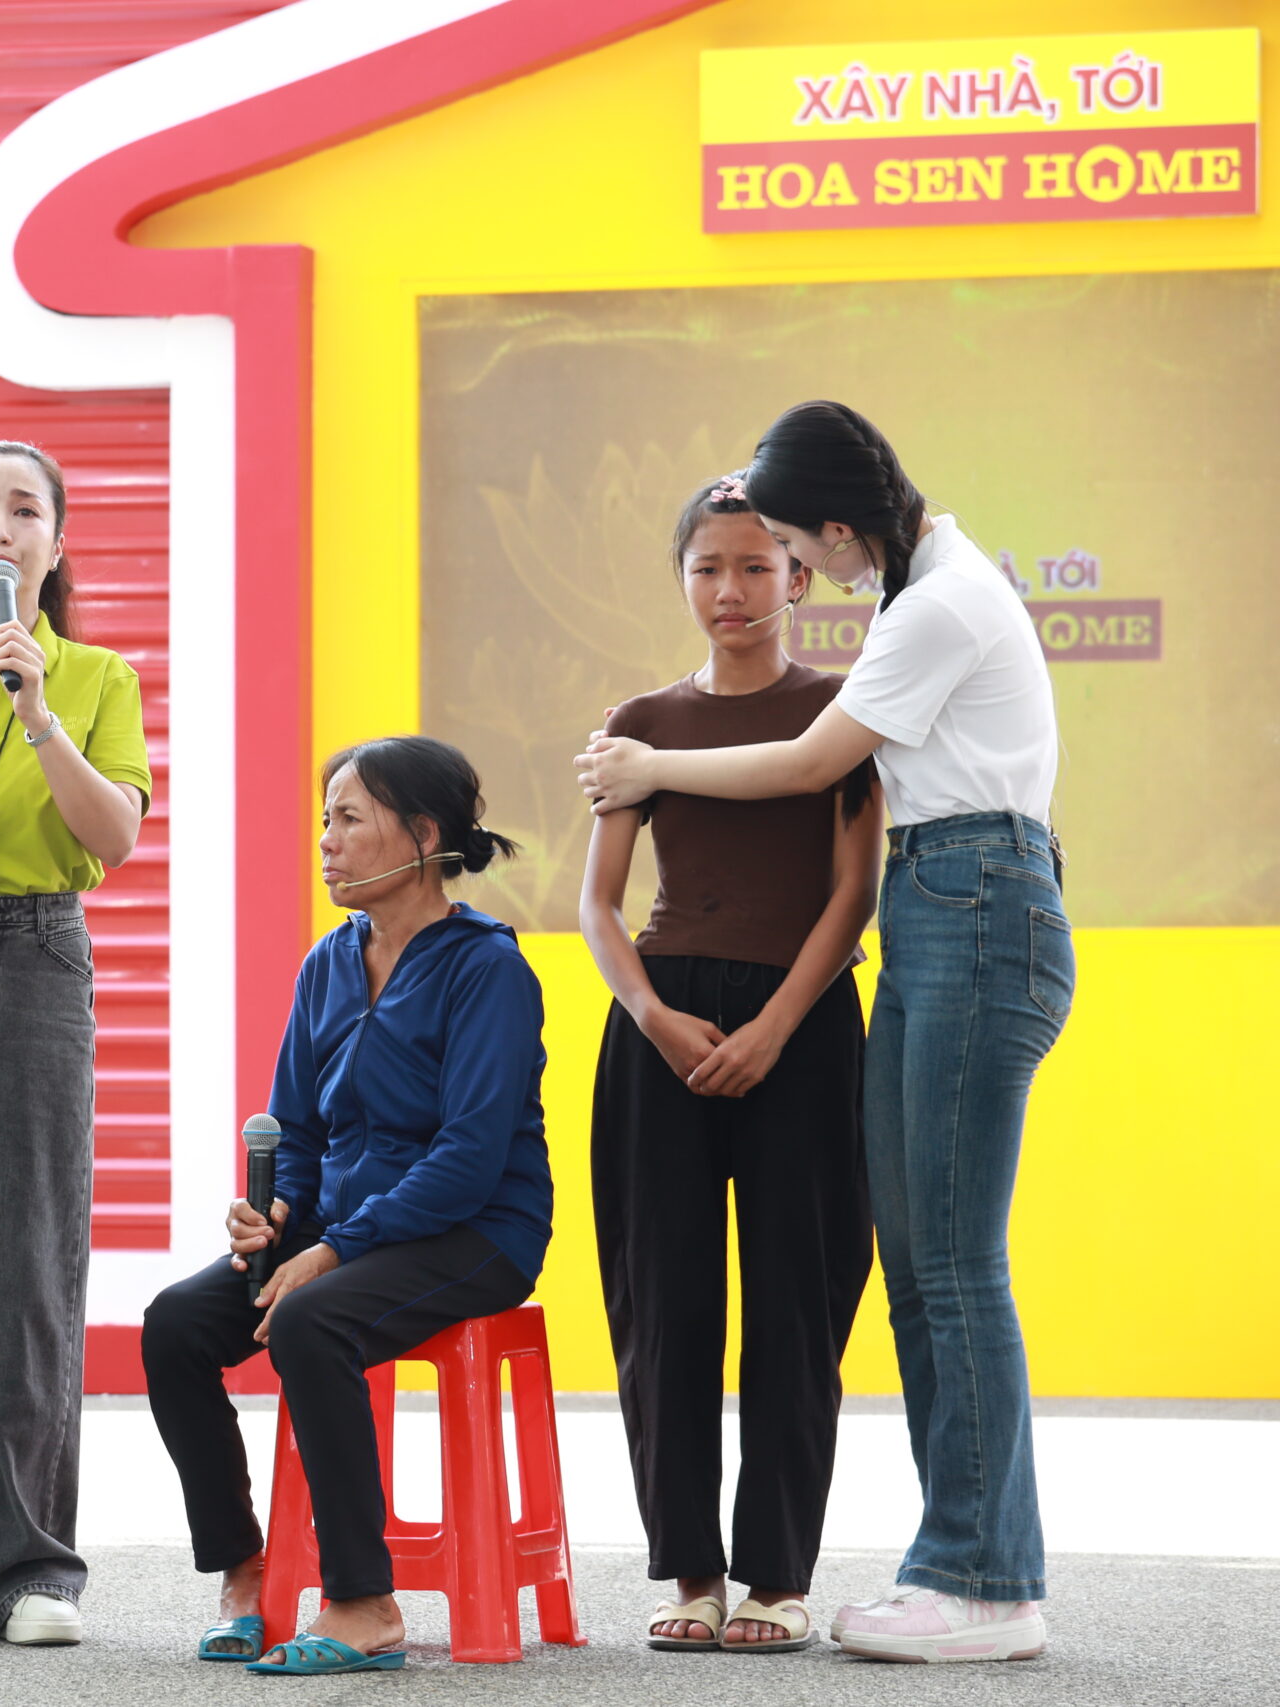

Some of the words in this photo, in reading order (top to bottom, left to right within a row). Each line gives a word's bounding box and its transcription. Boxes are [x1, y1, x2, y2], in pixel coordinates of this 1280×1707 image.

[797, 64, 910, 123] XÂY
[925, 57, 1058, 121] NHÀ,
[1073, 53, 1161, 111] TỚI
[717, 163, 859, 210] HOA
[874, 156, 1007, 205] SEN
[1022, 144, 1241, 203] HOME
[1037, 549, 1098, 590] TỚI
[801, 618, 866, 651] HO
[1033, 610, 1153, 651] OME
